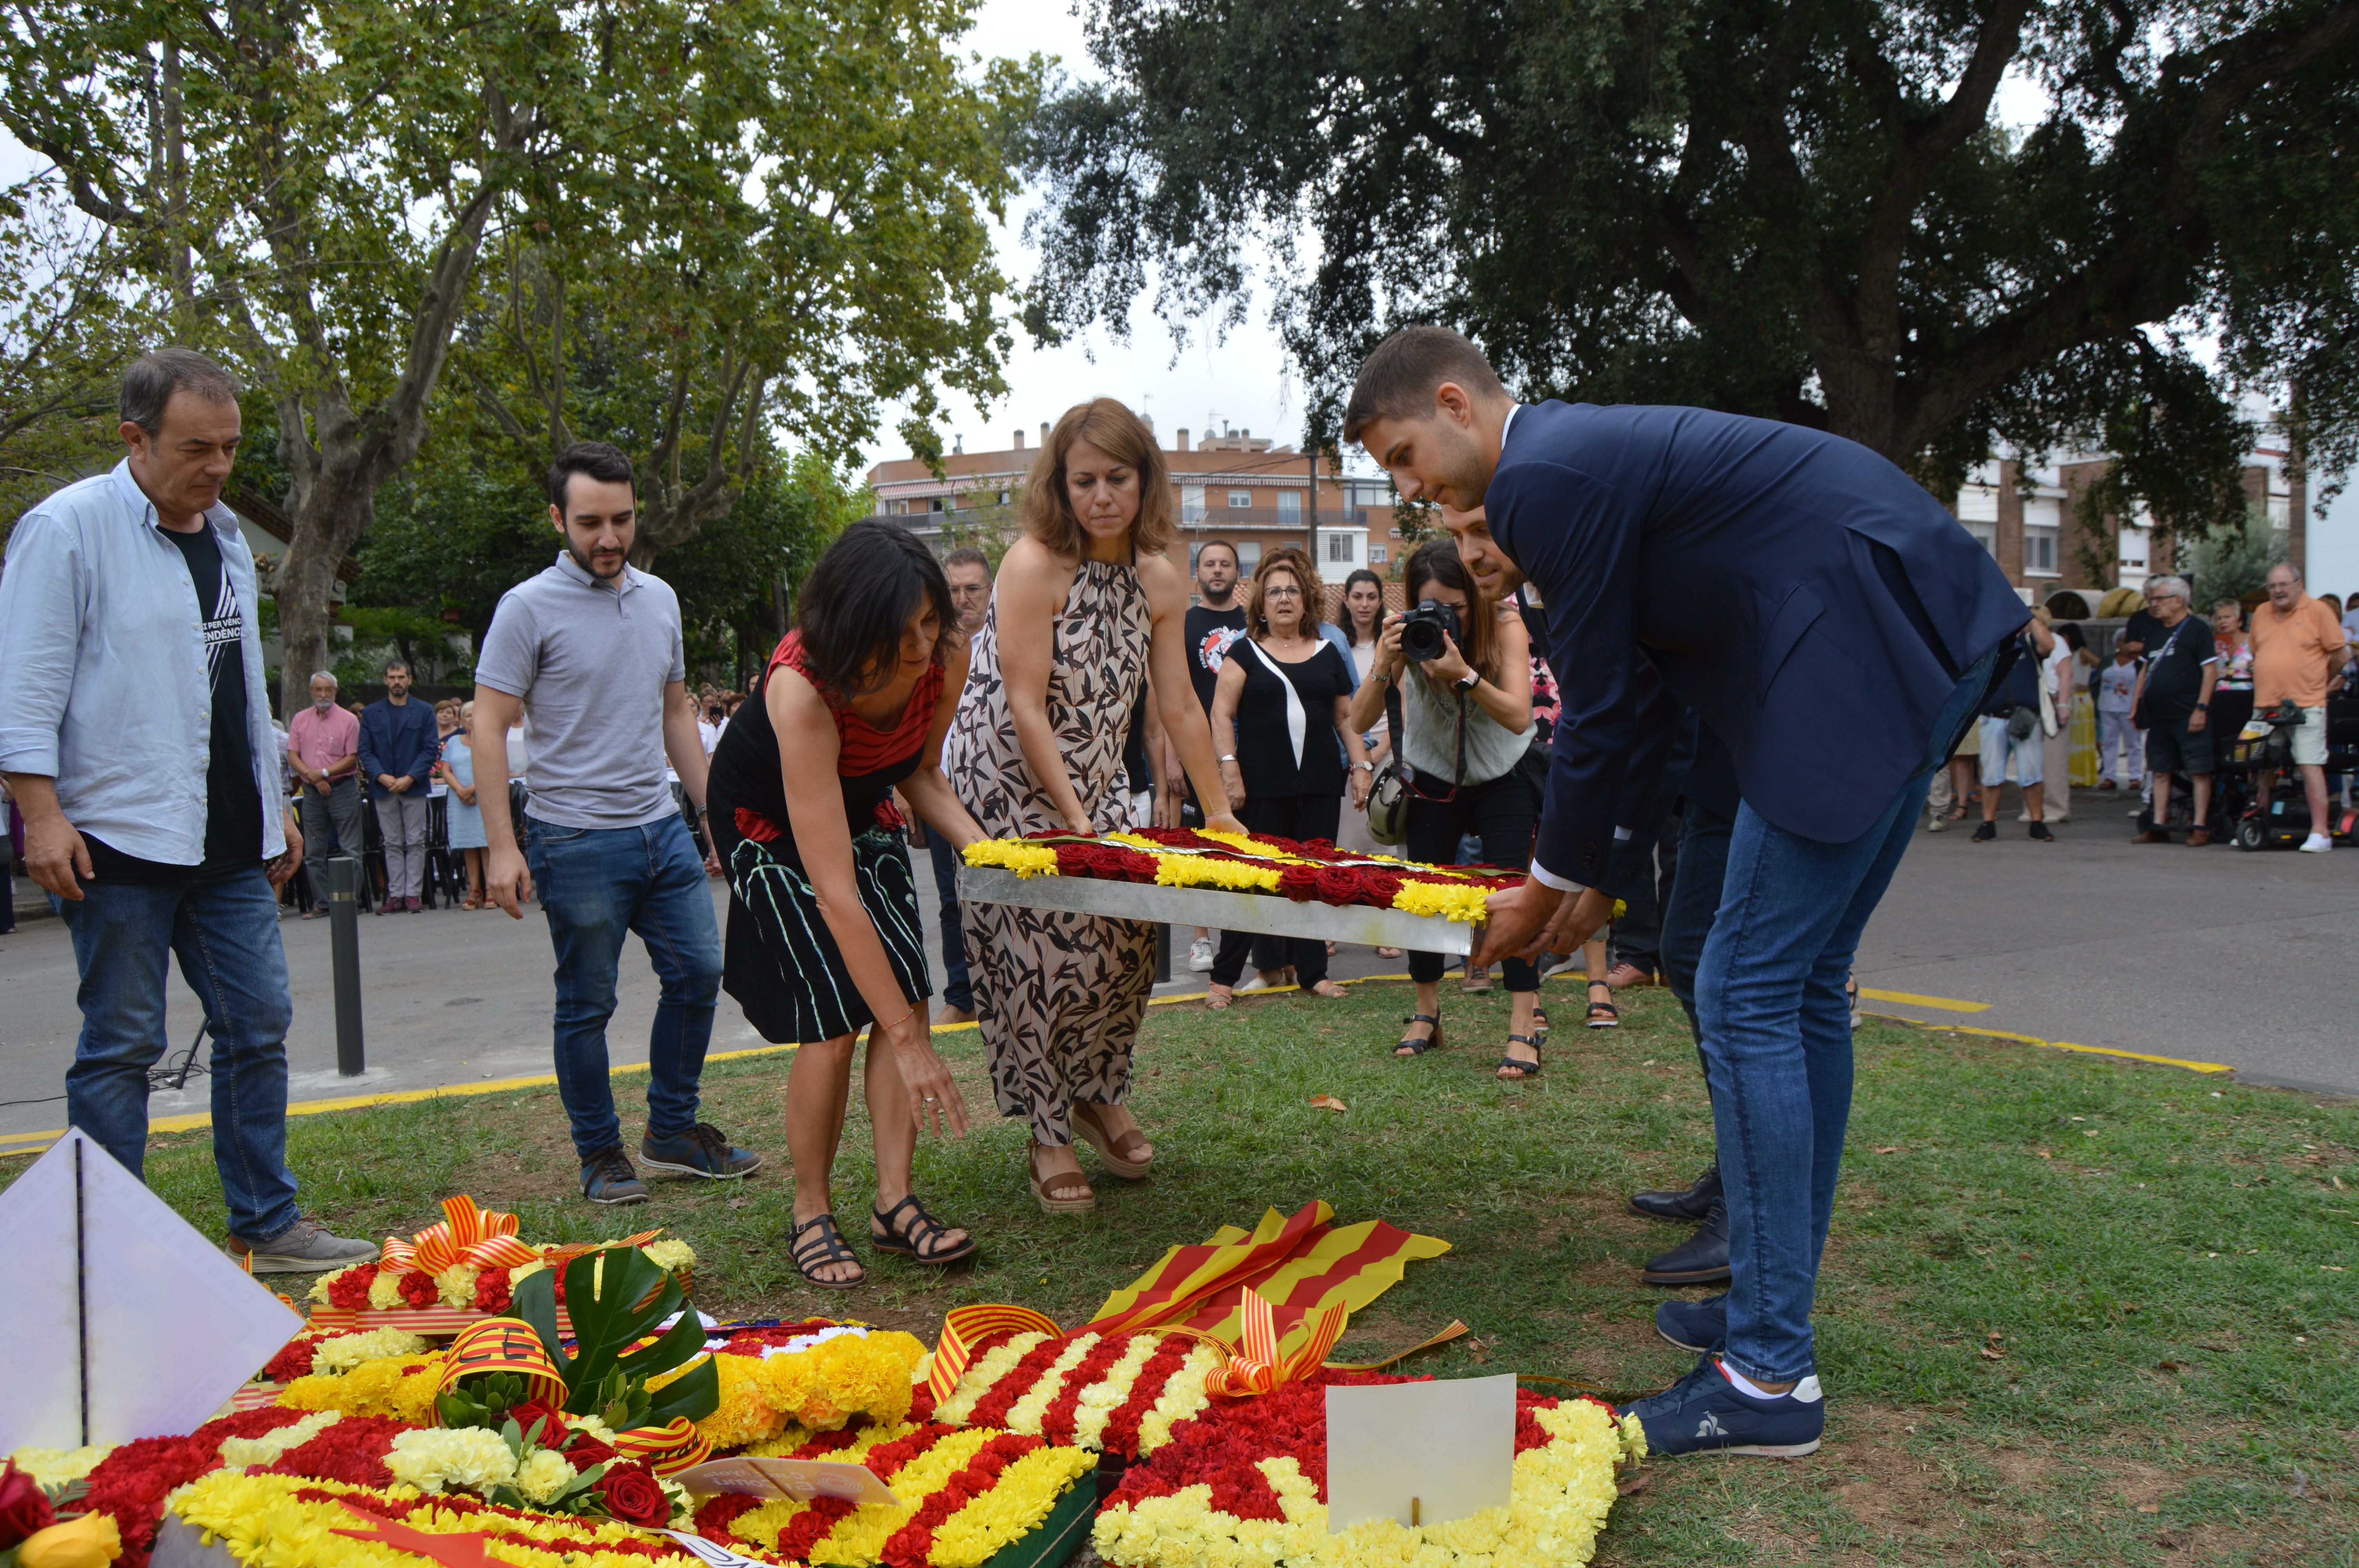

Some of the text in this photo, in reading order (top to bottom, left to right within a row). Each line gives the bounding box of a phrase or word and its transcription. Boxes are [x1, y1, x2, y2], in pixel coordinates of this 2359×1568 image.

[208, 621, 222, 629] PER
[222, 617, 241, 626] VÈNC
[204, 627, 241, 642] ENDÈNC
[1200, 637, 1209, 646] DEL
[1199, 648, 1208, 668] FAREM
